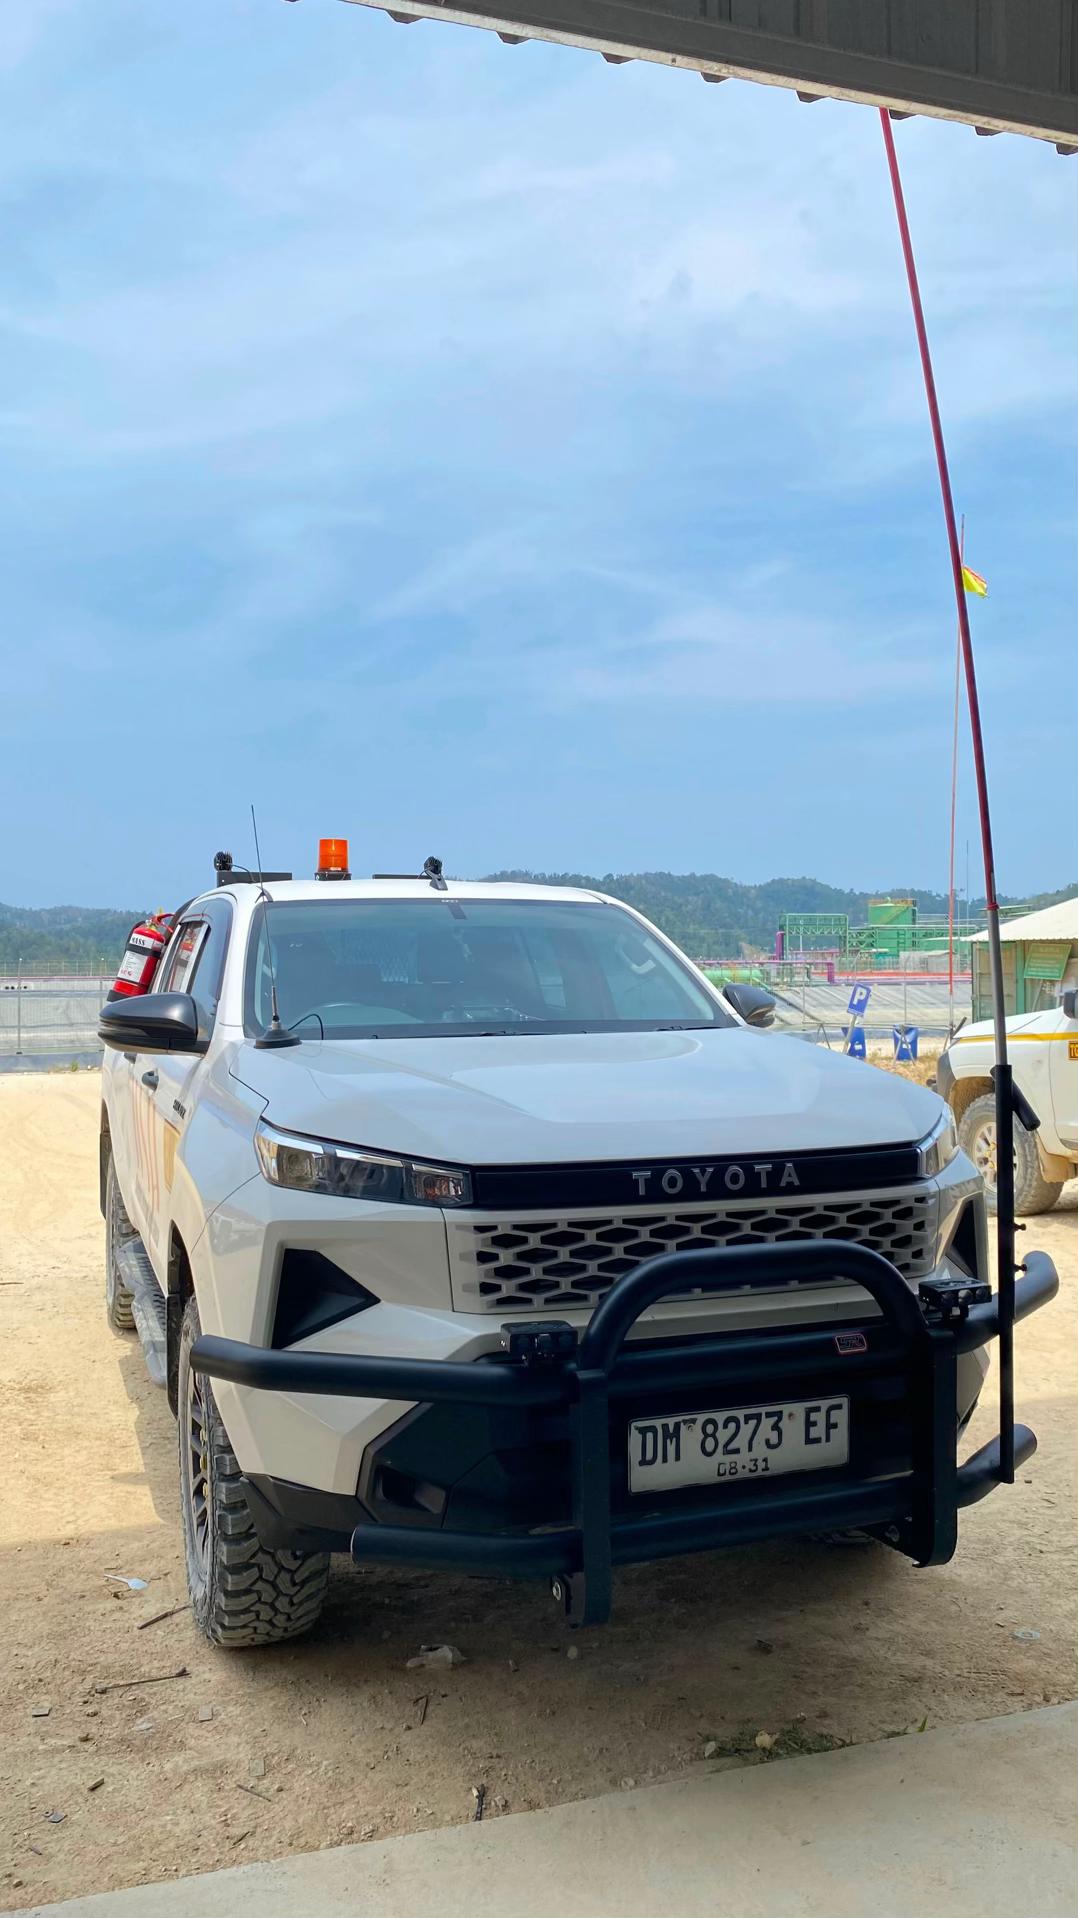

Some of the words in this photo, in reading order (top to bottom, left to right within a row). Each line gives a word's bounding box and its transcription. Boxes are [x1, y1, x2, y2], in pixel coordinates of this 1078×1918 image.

[852, 986, 867, 1006] P
[632, 1162, 801, 1196] TOYOTA
[634, 1420, 682, 1467] DM
[700, 1410, 784, 1458] 8273
[804, 1403, 843, 1446] EF
